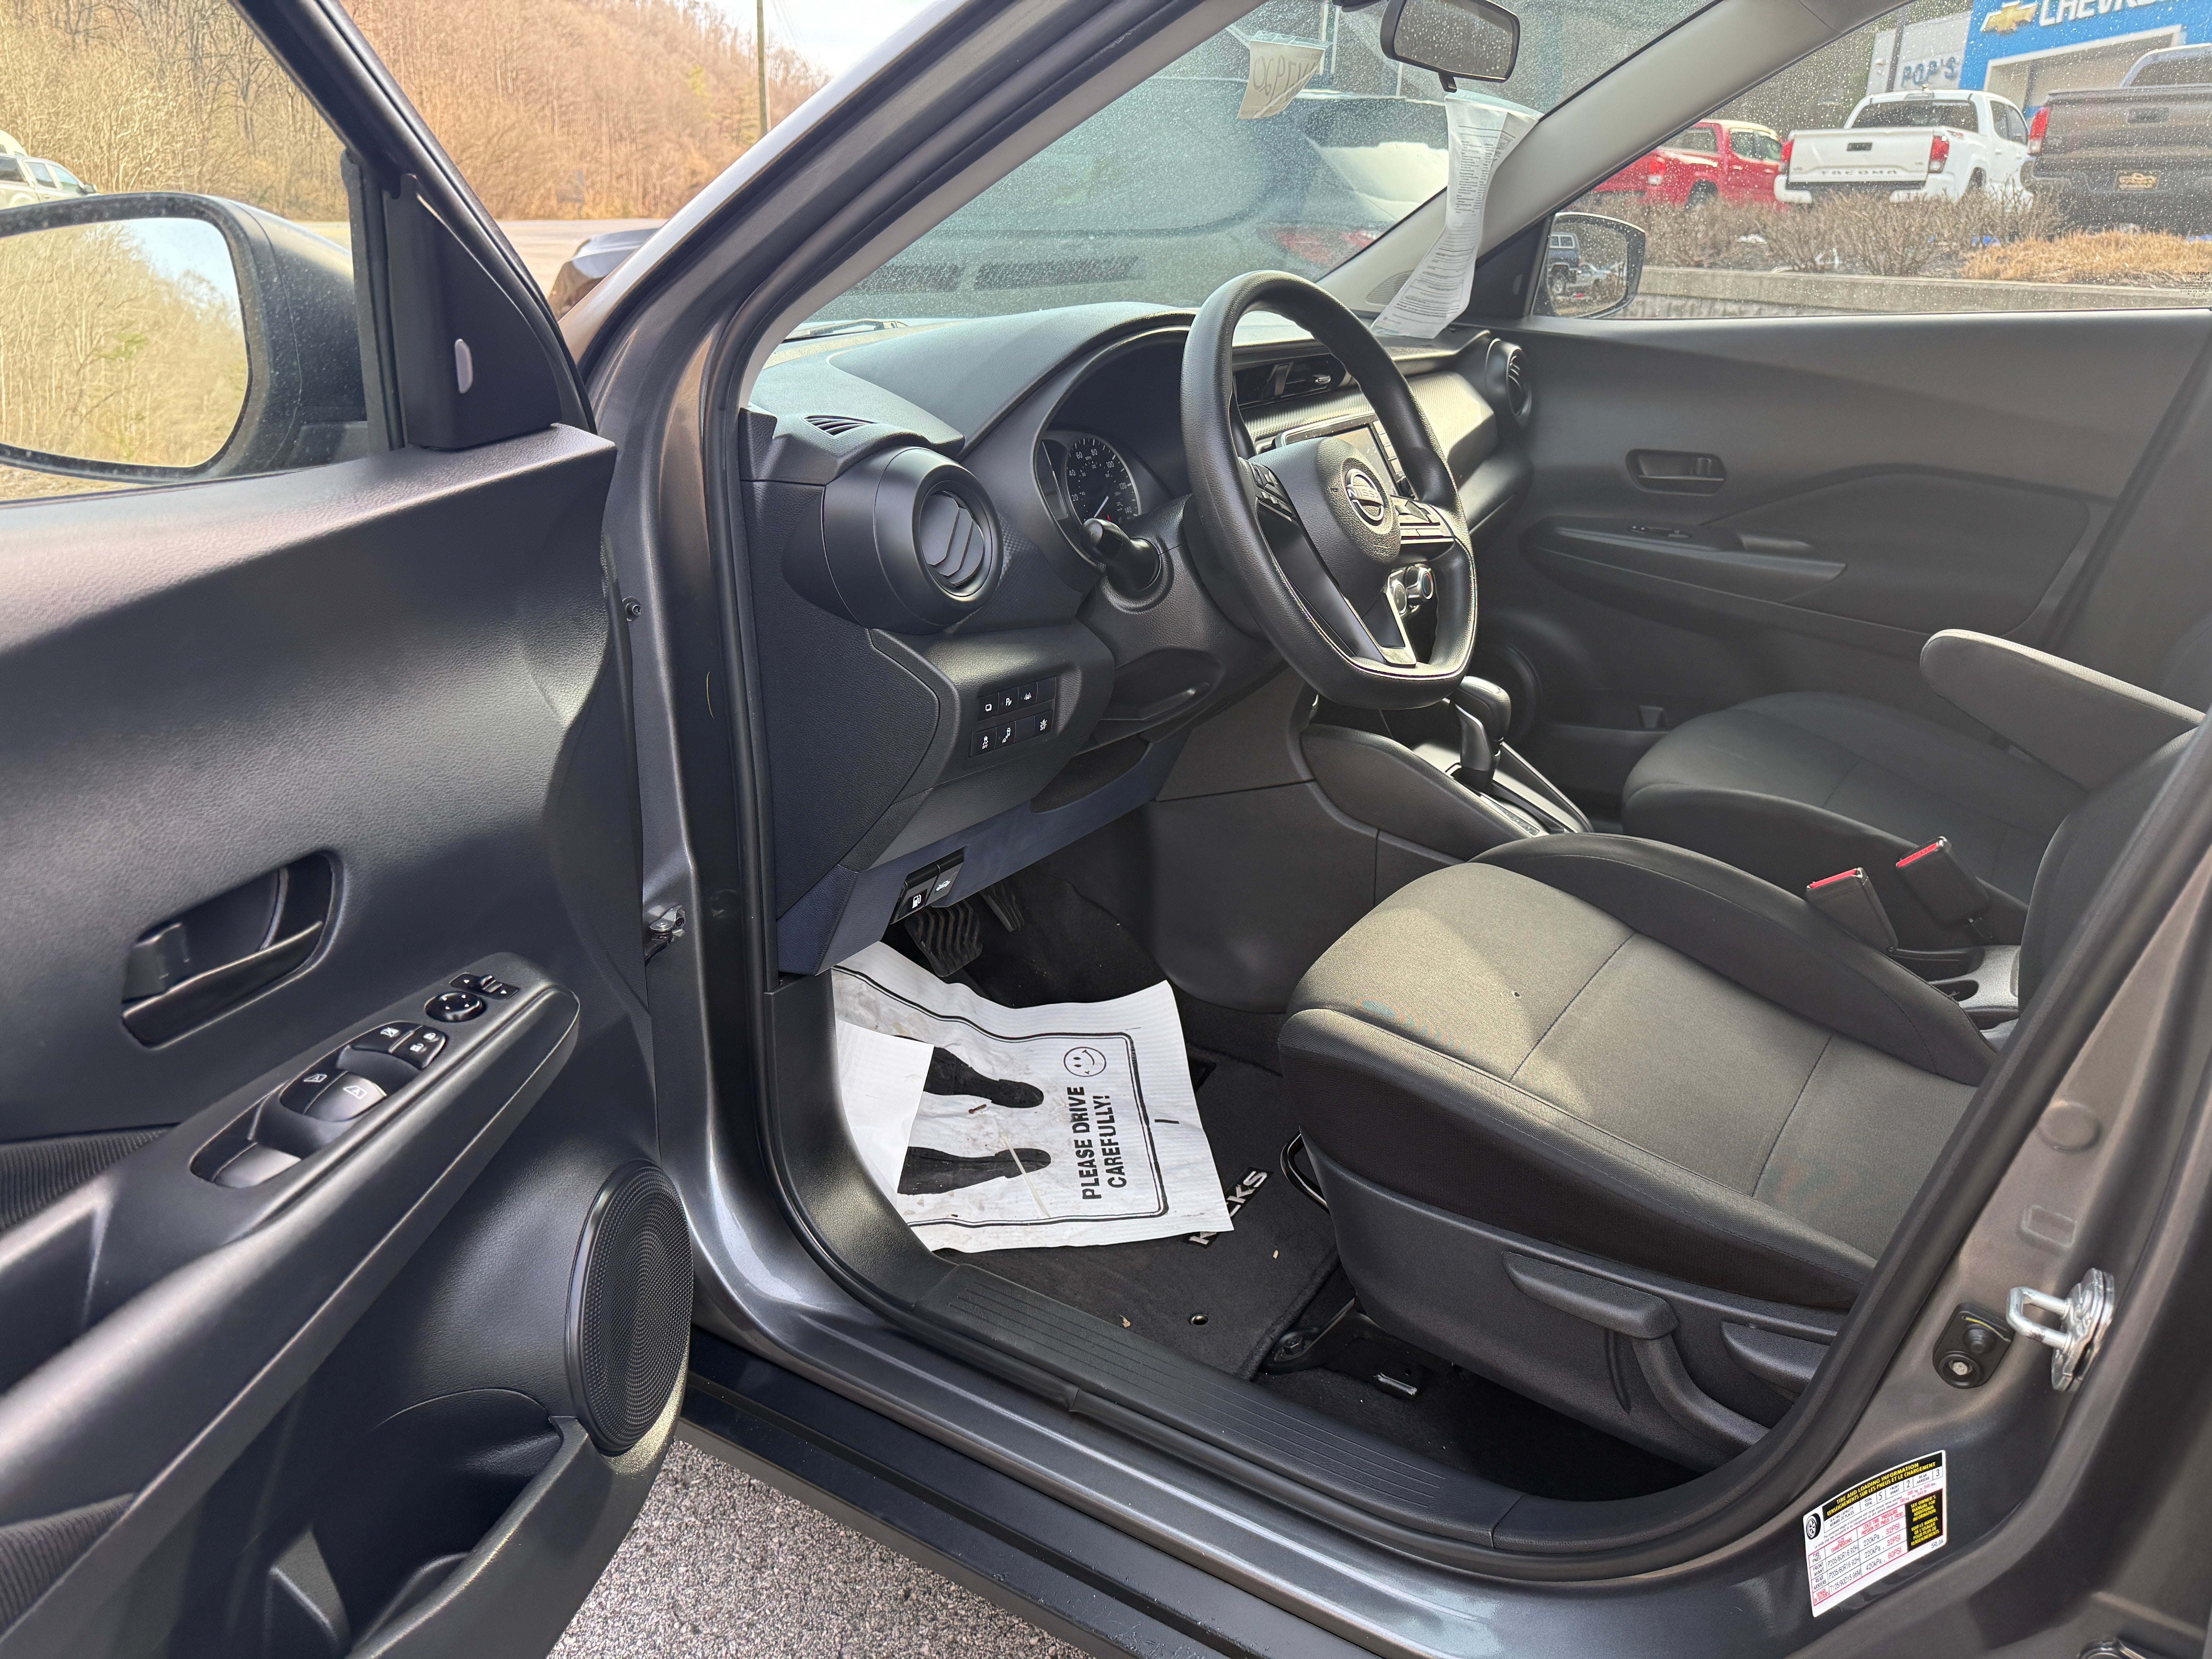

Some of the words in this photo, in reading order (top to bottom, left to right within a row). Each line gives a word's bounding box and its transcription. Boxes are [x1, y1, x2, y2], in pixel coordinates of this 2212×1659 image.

[1901, 57, 1956, 88] POP'S
[1067, 1087, 1090, 1133] DRIVE
[1093, 1096, 1127, 1188] CAREFULLY!
[1073, 1139, 1102, 1199] PLEASE
[1827, 1494, 1859, 1516] RENSEIGNEMENTS
[1877, 1479, 1891, 1489] PNEUS
[1904, 1462, 1936, 1477] CHARGEMENT
[1836, 1495, 1846, 1504] TIRE
[1847, 1490, 1857, 1499] AND
[1858, 1478, 1880, 1492] LOADING
[1881, 1463, 1919, 1481] INFORMATION
[1879, 1492, 1882, 1500] 5
[1918, 1494, 1936, 1505] OWNER'S
[1911, 1503, 1927, 1513] MANUAL
[1913, 1505, 1934, 1516] ADDITIONAL
[1882, 1509, 1898, 1520] PRESSURE
[1913, 1509, 1936, 1522] INFORMATION
[1924, 1516, 1939, 1526] MANUEL
[1886, 1523, 1900, 1535] 32PSI
[1887, 1534, 1901, 1546] 32PSI
[1911, 1529, 1940, 1546] RENSEIGNEMENTS
[1831, 1537, 1852, 1553] DIMENSIONS
[1888, 1547, 1902, 1559] 60PSI
[1812, 1555, 1821, 1564] PNEU
[1813, 1562, 1824, 1571] FRONT
[1814, 1567, 1824, 1577] AVANT
